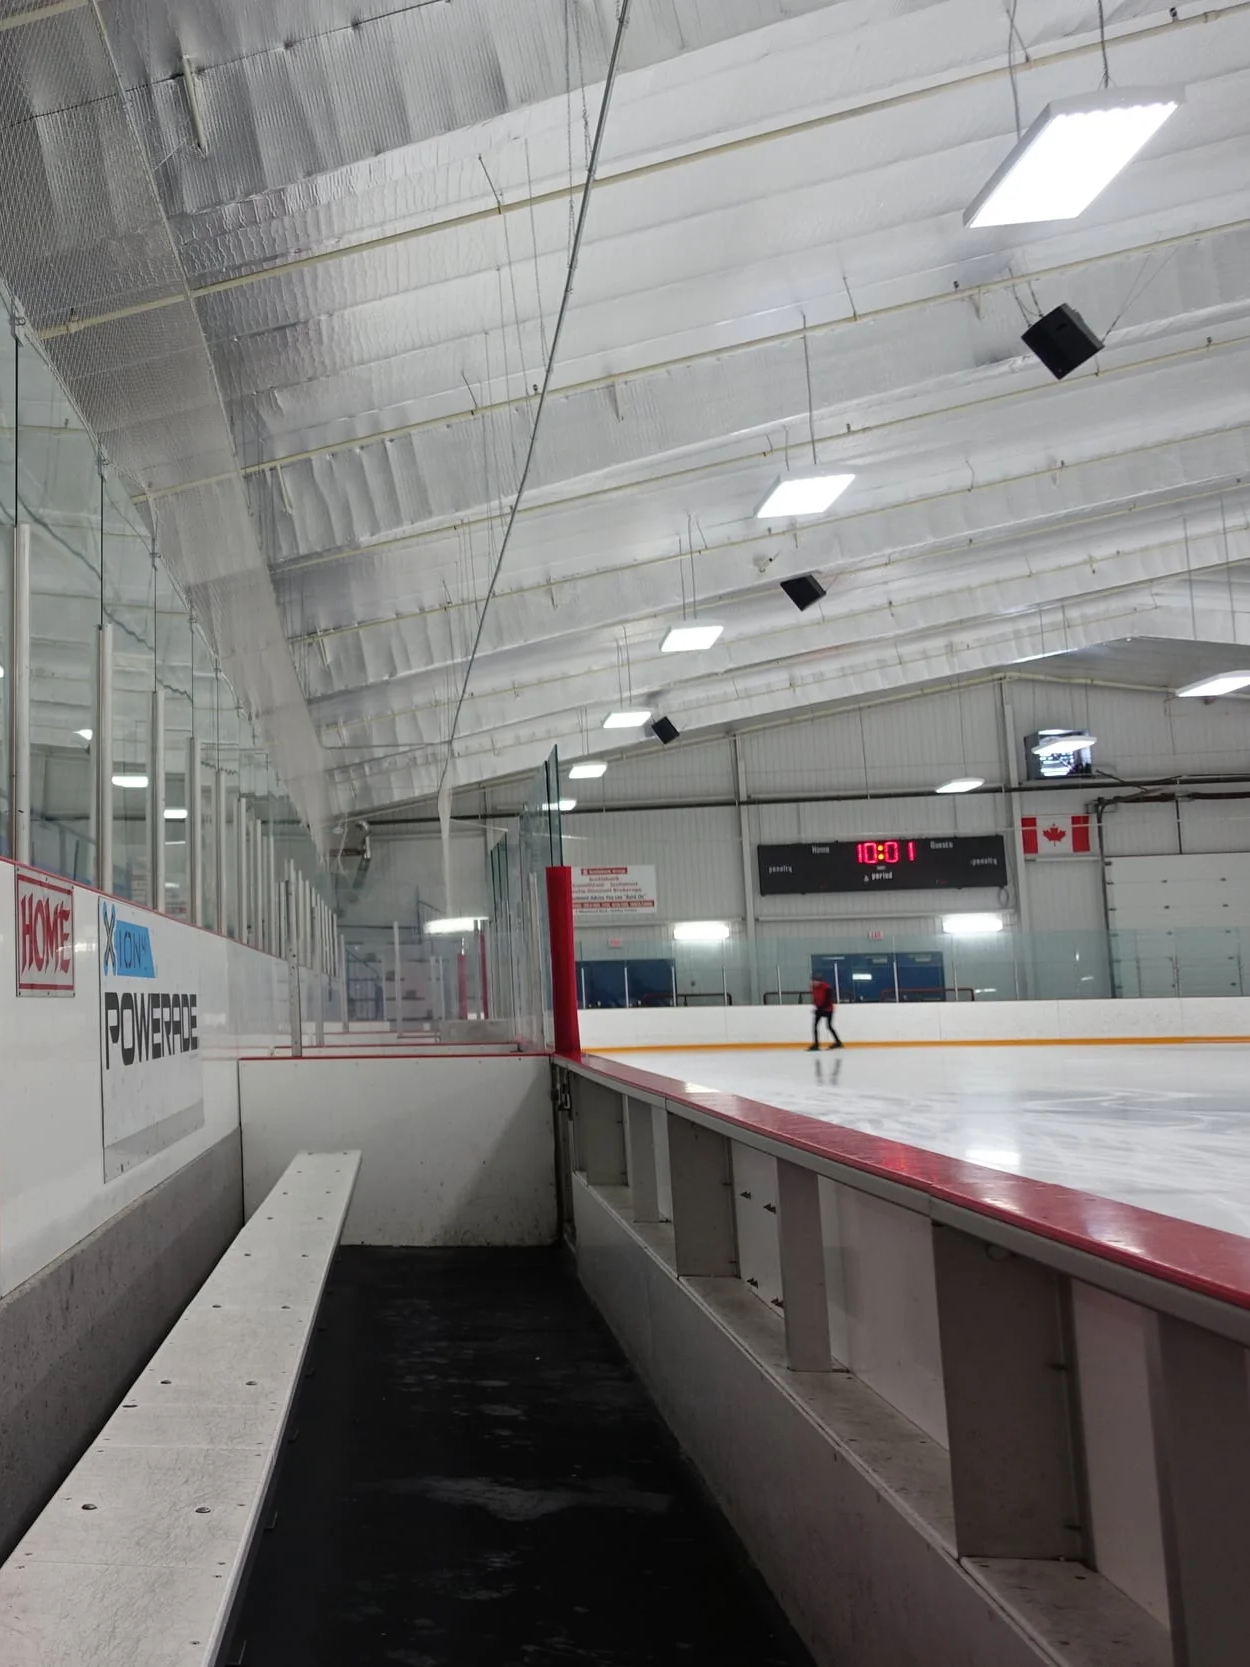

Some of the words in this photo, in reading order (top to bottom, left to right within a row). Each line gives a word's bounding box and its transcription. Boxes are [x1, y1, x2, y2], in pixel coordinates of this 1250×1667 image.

[856, 840, 915, 864] 10:01
[21, 893, 71, 975] HOME
[104, 991, 198, 1070] POWERADE
